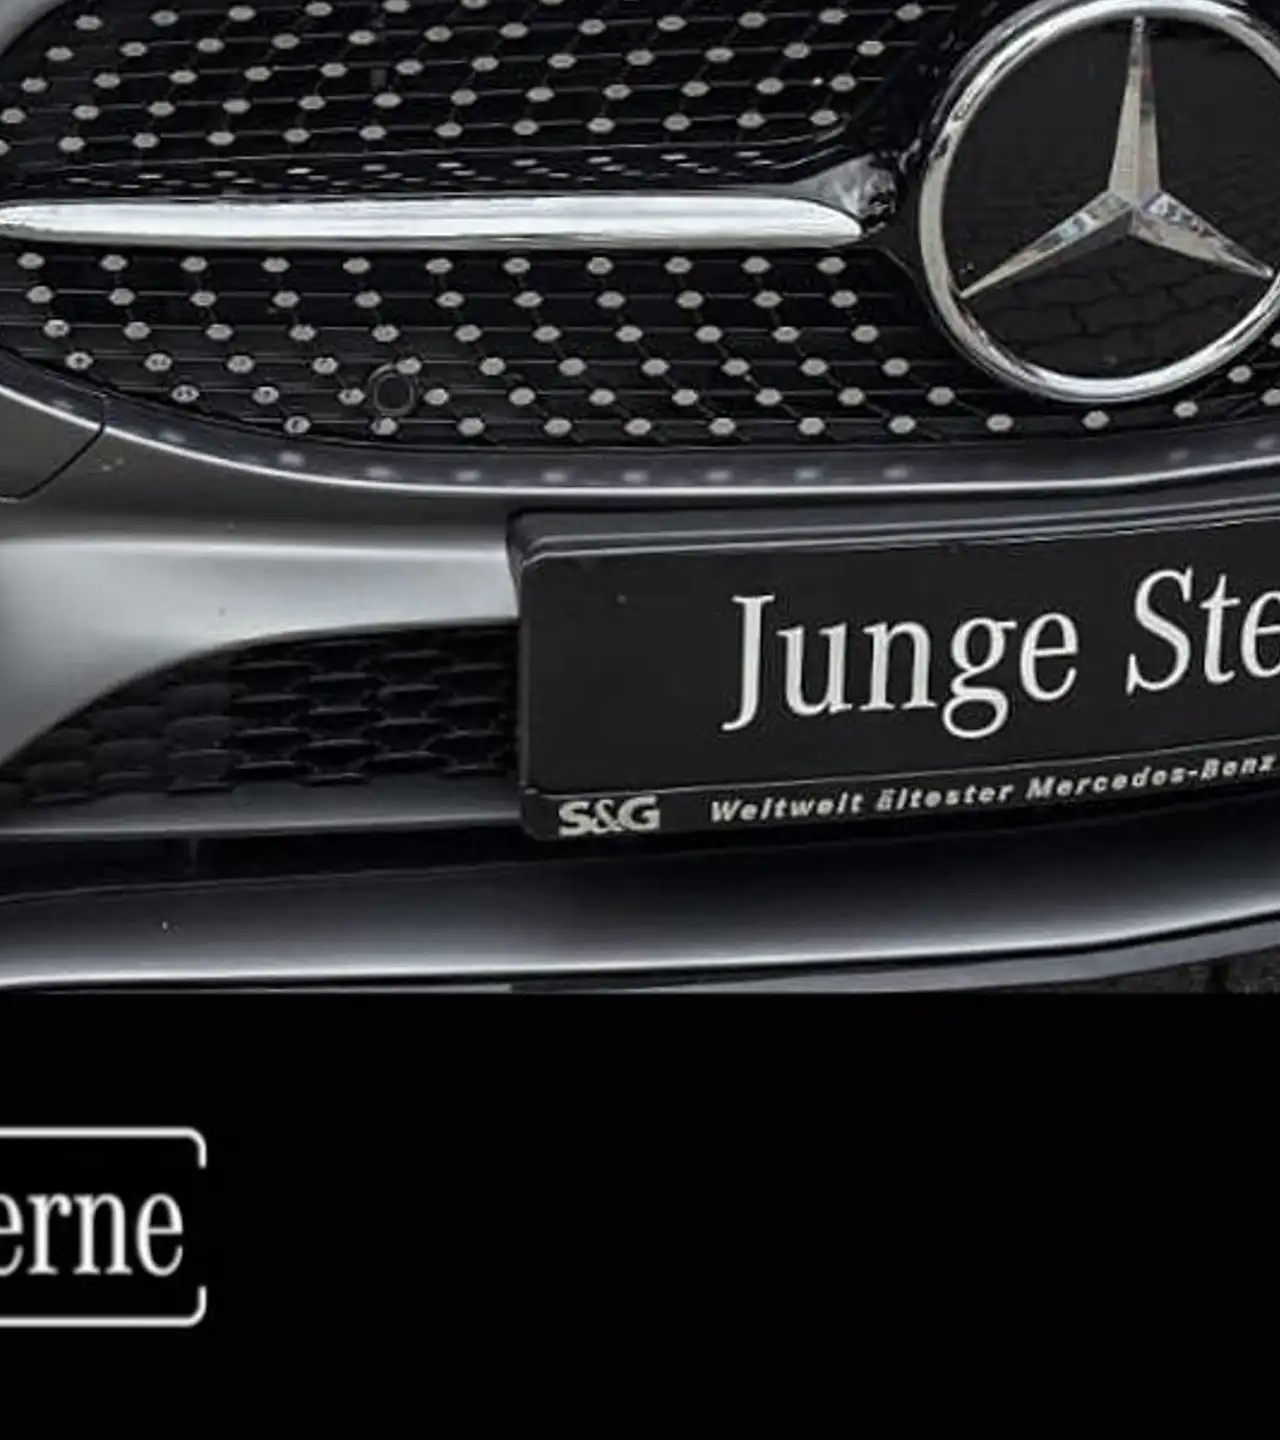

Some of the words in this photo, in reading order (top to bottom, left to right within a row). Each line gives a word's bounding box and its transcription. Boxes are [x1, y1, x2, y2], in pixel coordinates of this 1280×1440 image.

[721, 593, 1080, 740] Junge
[558, 795, 661, 837] S&G
[711, 791, 864, 823] Weltweit
[1025, 752, 1276, 801] Mercedes-Benz
